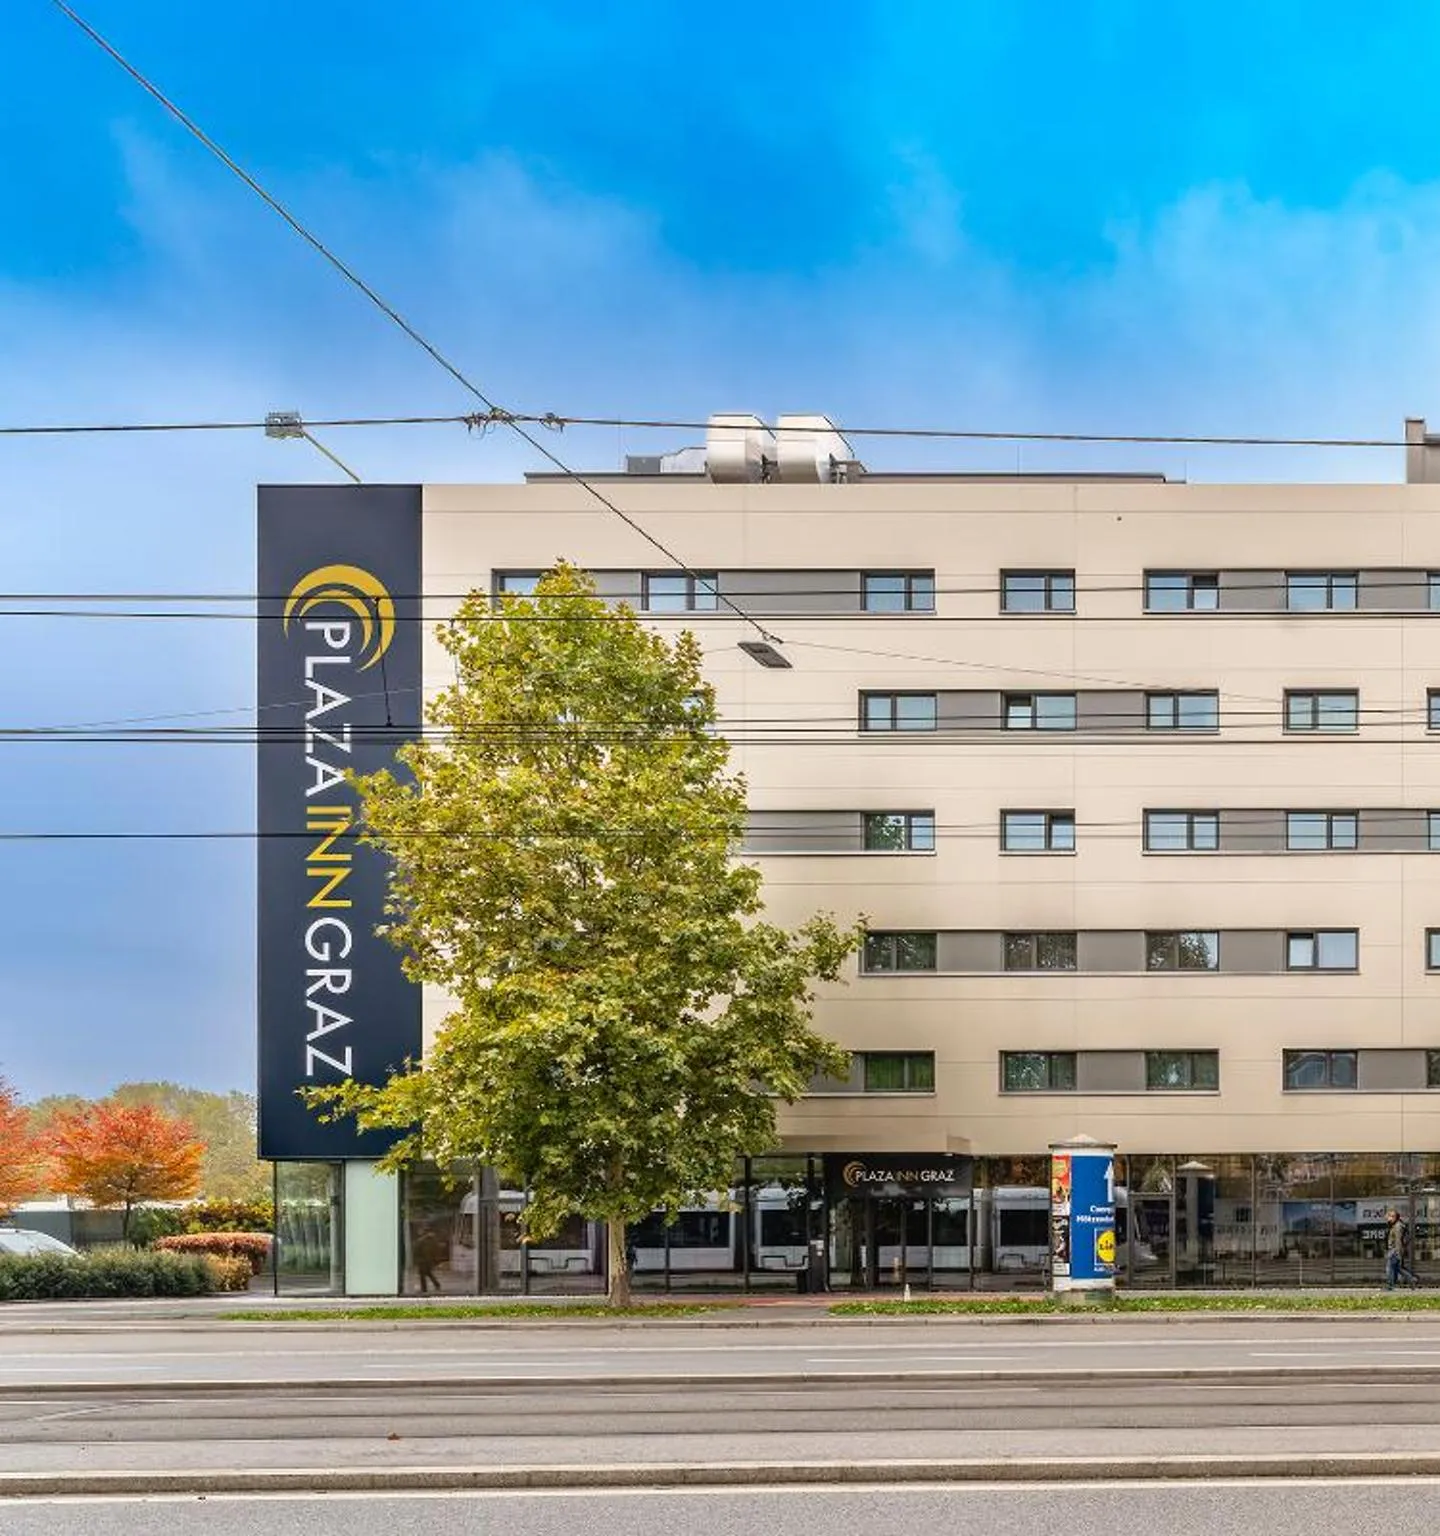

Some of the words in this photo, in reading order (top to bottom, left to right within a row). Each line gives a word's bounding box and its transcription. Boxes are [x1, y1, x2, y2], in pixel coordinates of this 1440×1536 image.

[304, 621, 353, 797] PLAZA
[305, 805, 353, 908] INN
[304, 916, 354, 1077] GRAZ
[855, 1169, 895, 1182] PLAZA
[896, 1169, 919, 1182] INN
[919, 1168, 956, 1182] GRAZ
